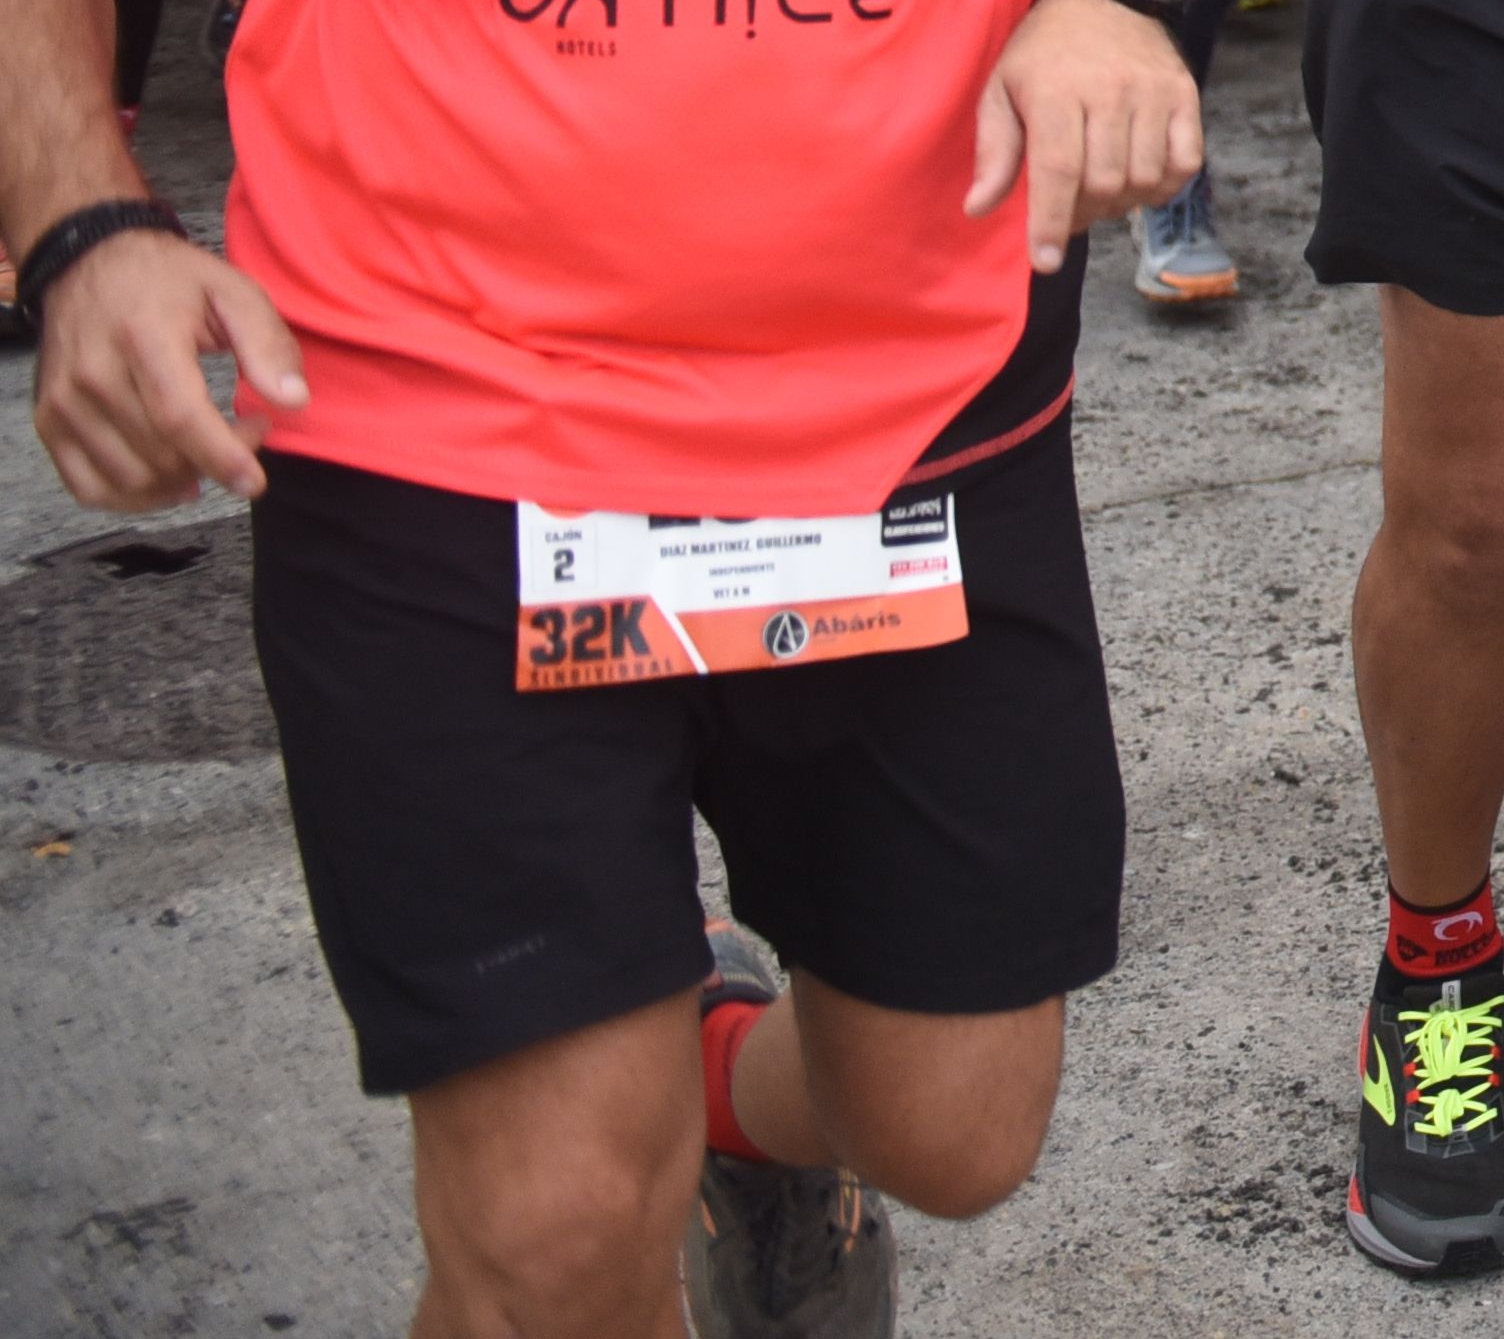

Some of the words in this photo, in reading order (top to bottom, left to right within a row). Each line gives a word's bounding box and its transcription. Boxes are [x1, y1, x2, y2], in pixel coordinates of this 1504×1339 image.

[555, 39, 618, 58] HOTELS
[553, 548, 576, 582] 2
[529, 598, 652, 666] 32K
